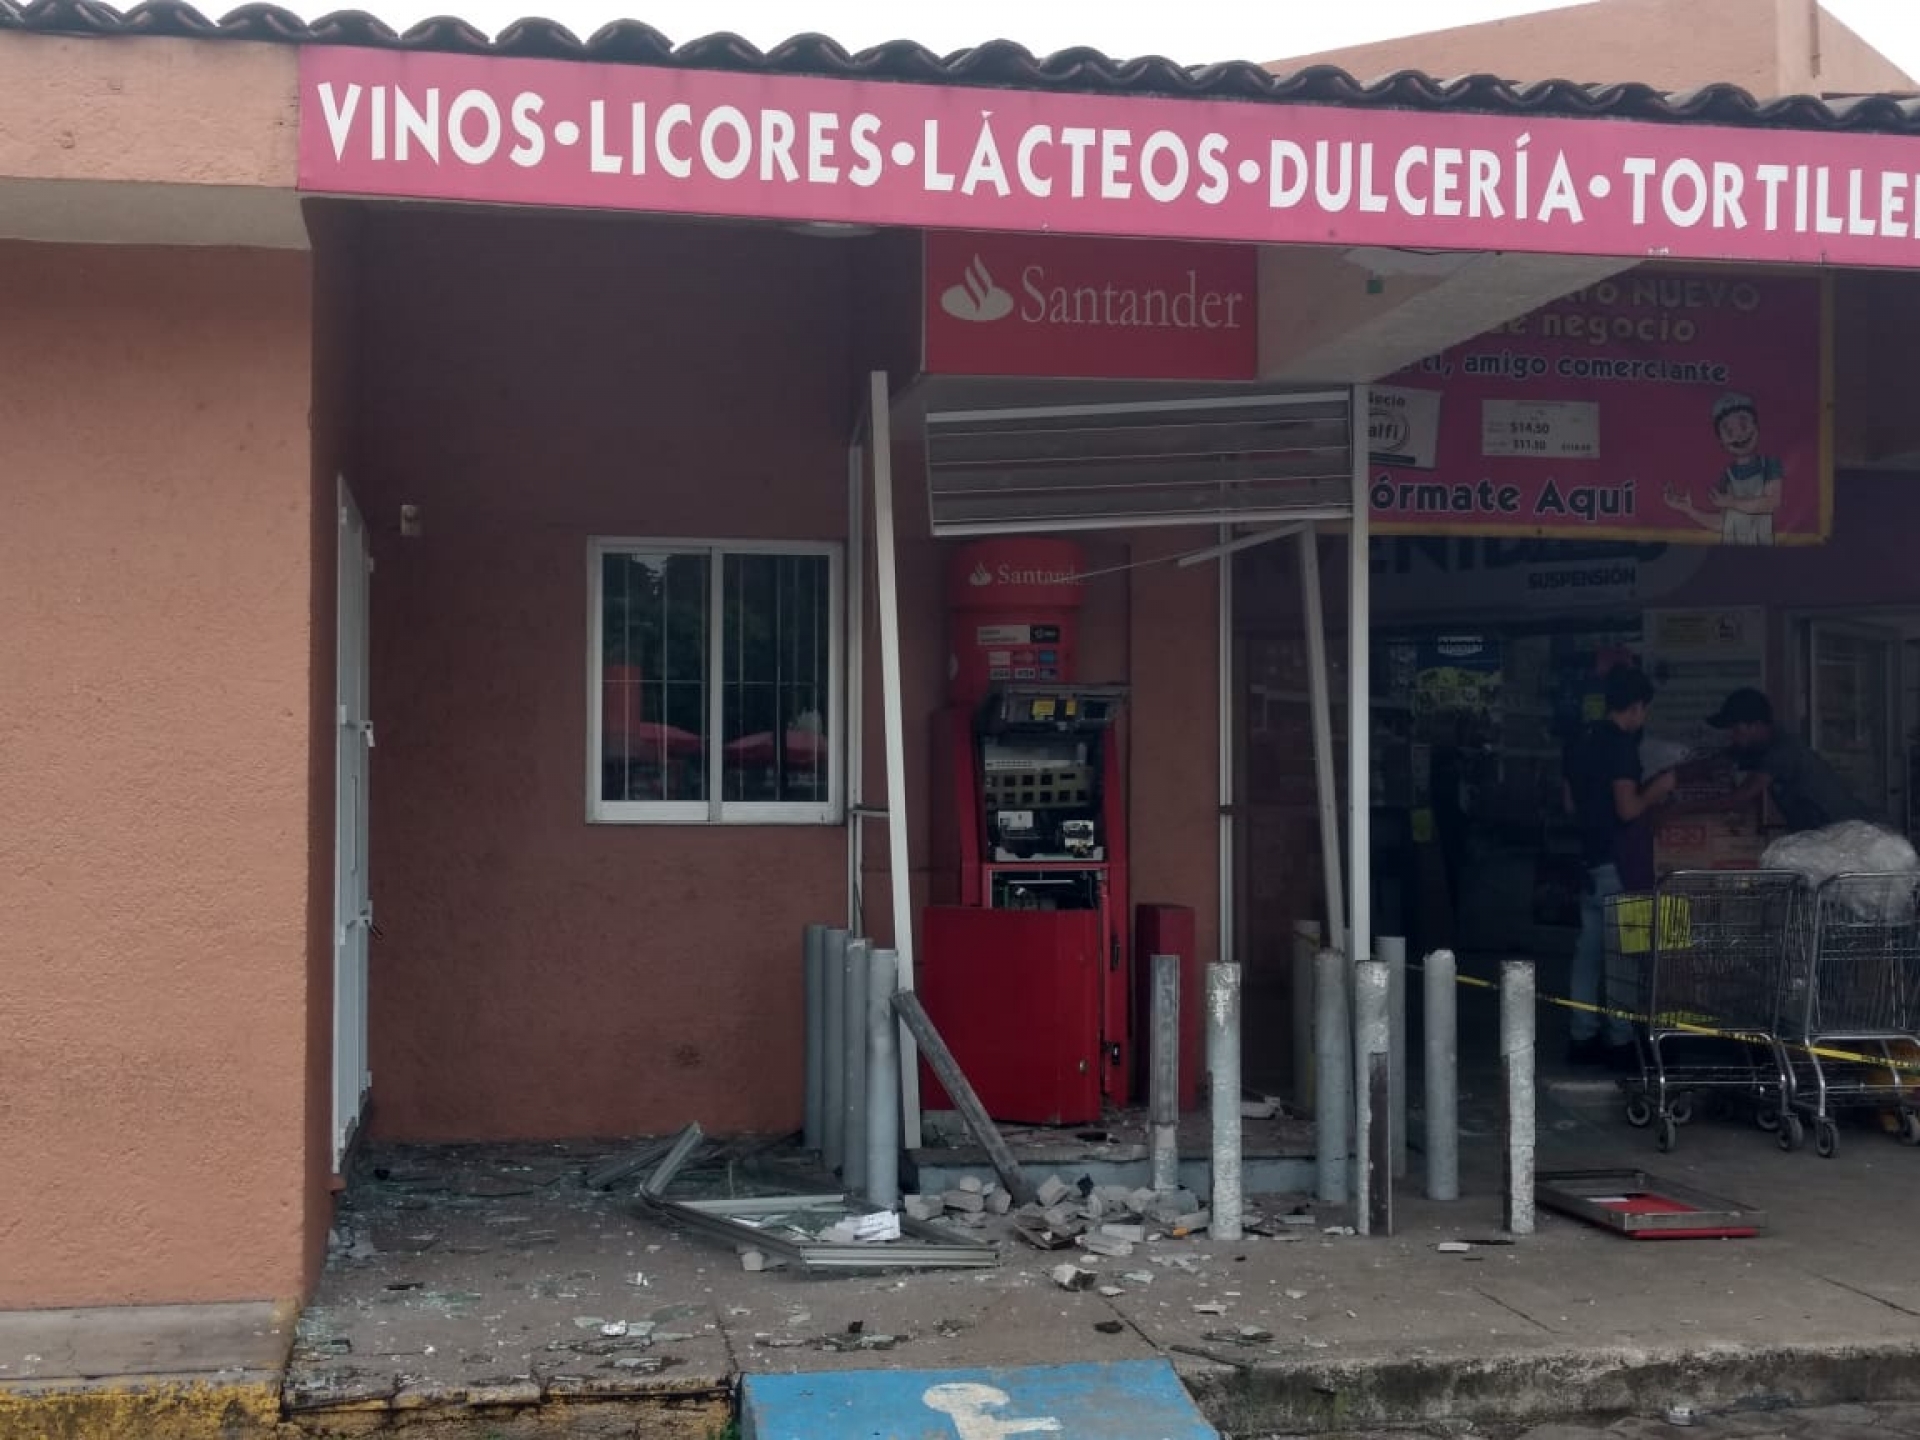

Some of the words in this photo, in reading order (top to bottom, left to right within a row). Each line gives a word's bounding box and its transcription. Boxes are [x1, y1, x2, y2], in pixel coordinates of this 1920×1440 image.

[318, 81, 544, 167] VINOS
[590, 99, 883, 188] LICORES
[1269, 132, 1584, 223] DULCERÍA
[1020, 264, 1243, 328] Santander
[1631, 279, 1761, 311] NUEVO
[1541, 309, 1697, 346] negocio
[1463, 348, 1547, 378] amigo
[1556, 351, 1728, 384] comerciante
[1534, 479, 1636, 521] Aquí
